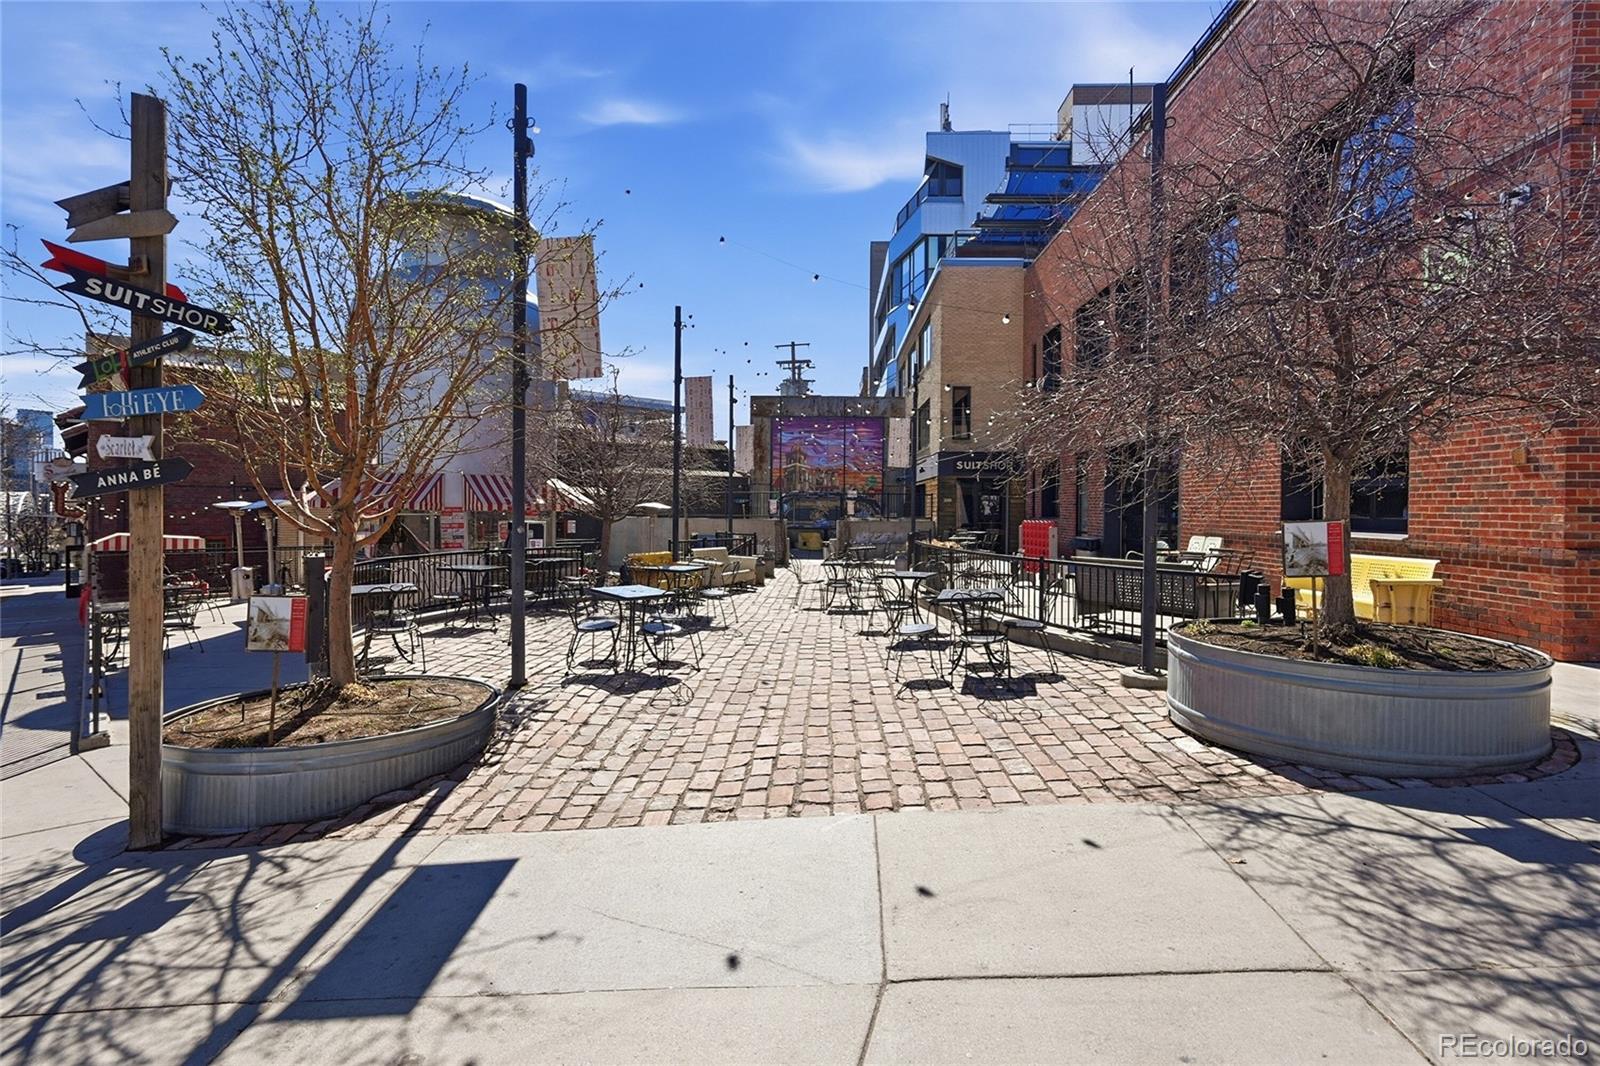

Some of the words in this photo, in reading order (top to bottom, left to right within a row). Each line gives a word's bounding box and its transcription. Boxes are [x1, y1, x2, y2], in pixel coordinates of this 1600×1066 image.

[84, 277, 219, 330] SUITSHOP
[132, 343, 162, 359] ATHLETIC
[161, 336, 179, 349] CLUB
[97, 470, 139, 488] ANNA
[142, 463, 161, 480] BÉ
